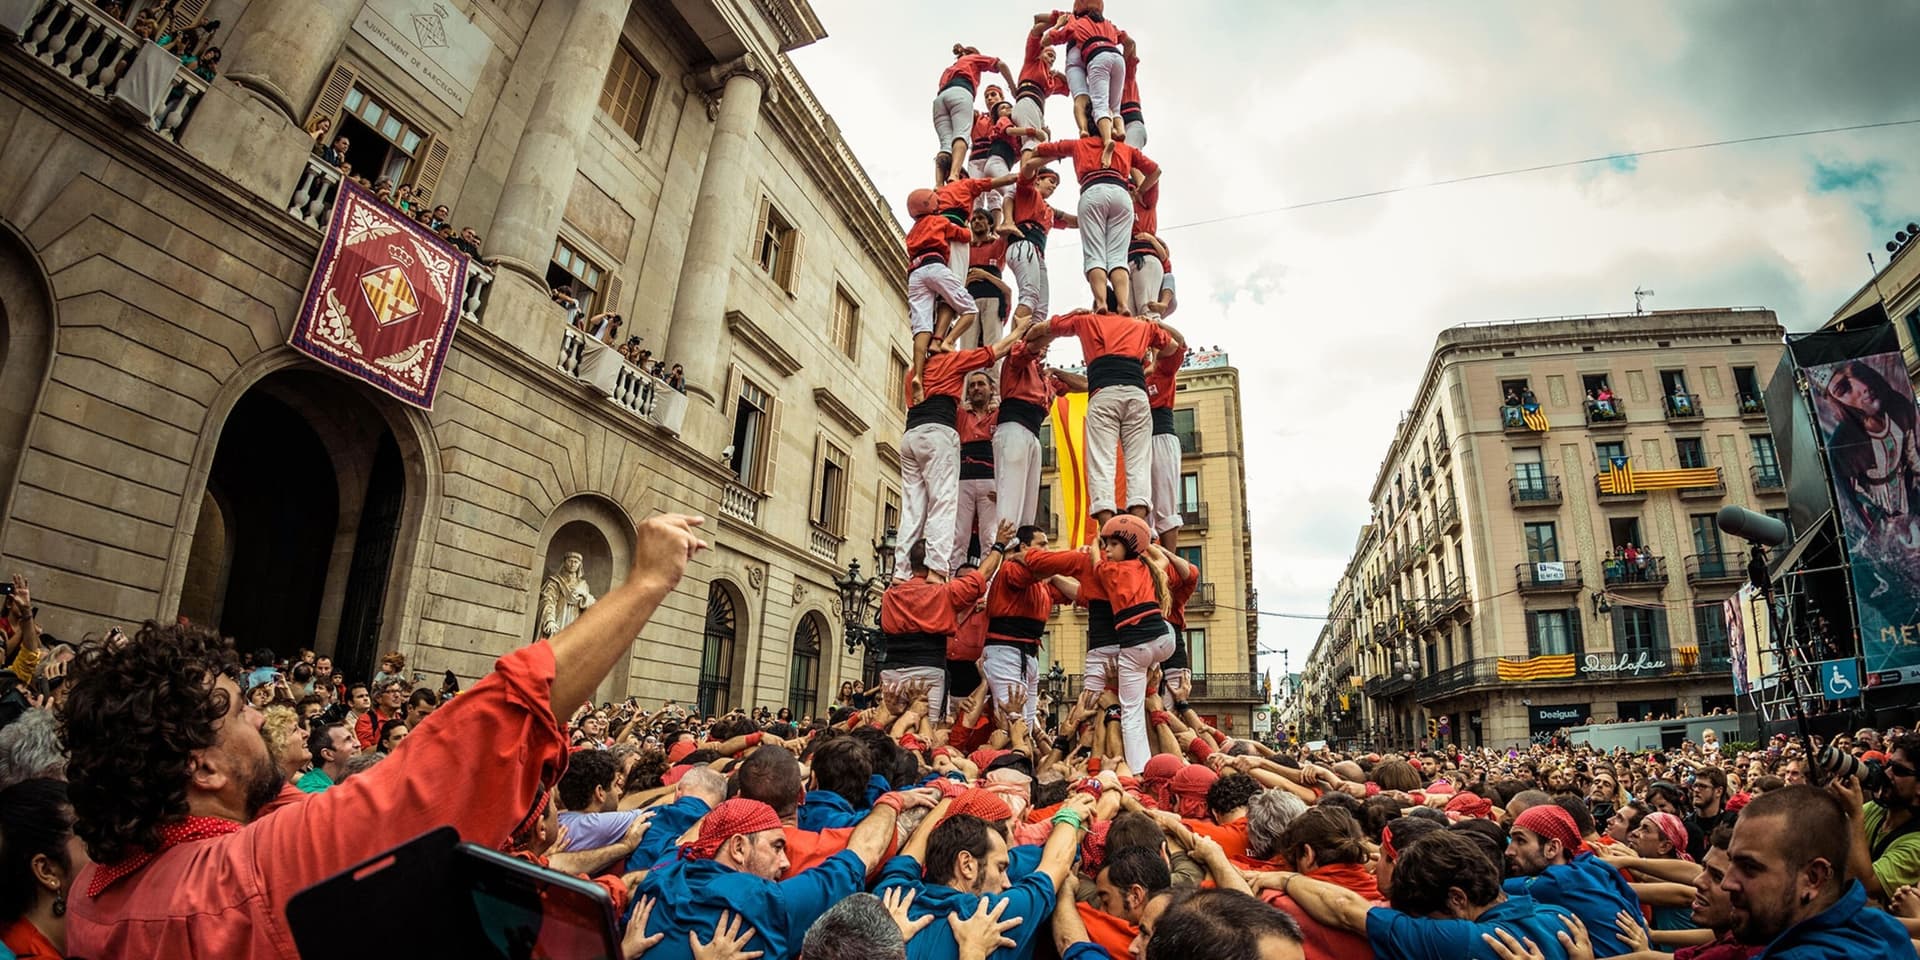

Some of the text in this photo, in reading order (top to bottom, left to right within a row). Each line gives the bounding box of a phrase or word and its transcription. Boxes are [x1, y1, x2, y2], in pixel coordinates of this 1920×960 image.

[364, 20, 463, 104] AJUNTAMENT DE BARCELONA
[1880, 622, 1920, 646] ME
